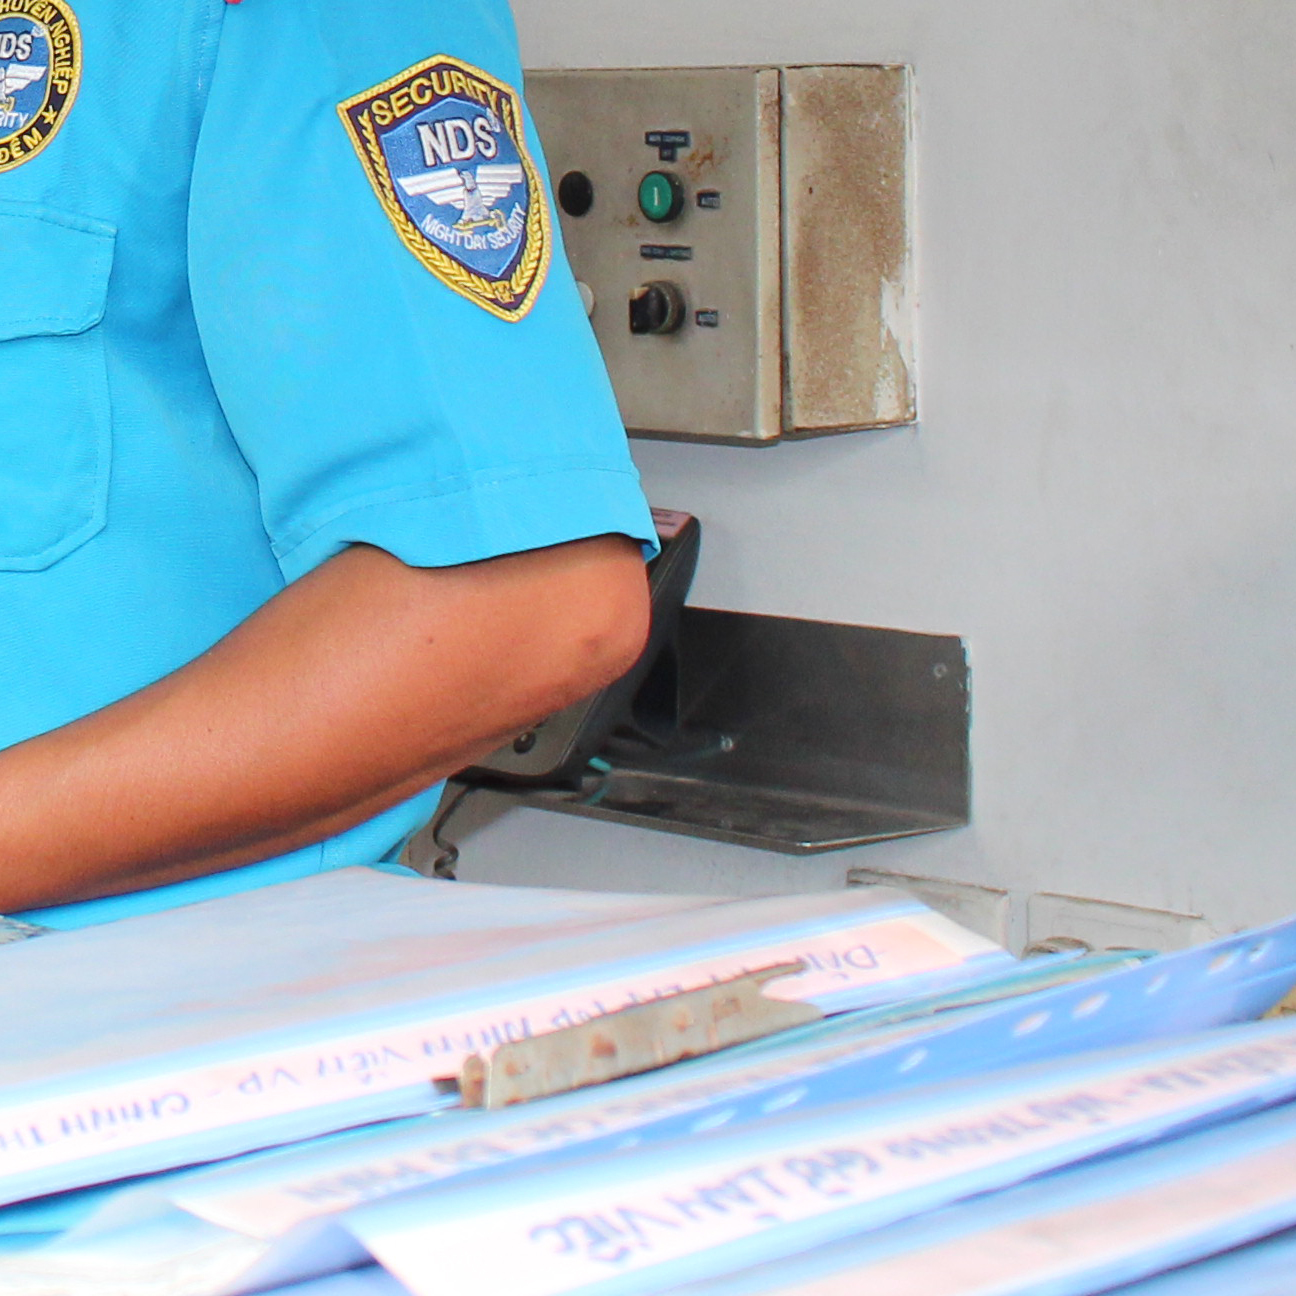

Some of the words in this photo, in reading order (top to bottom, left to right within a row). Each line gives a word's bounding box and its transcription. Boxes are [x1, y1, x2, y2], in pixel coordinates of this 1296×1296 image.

[372, 70, 499, 127] SECURITY
[417, 116, 497, 167] NDS
[421, 214, 466, 247] NIGHT
[464, 231, 491, 250] DAY
[490, 202, 527, 250] SECURITY
